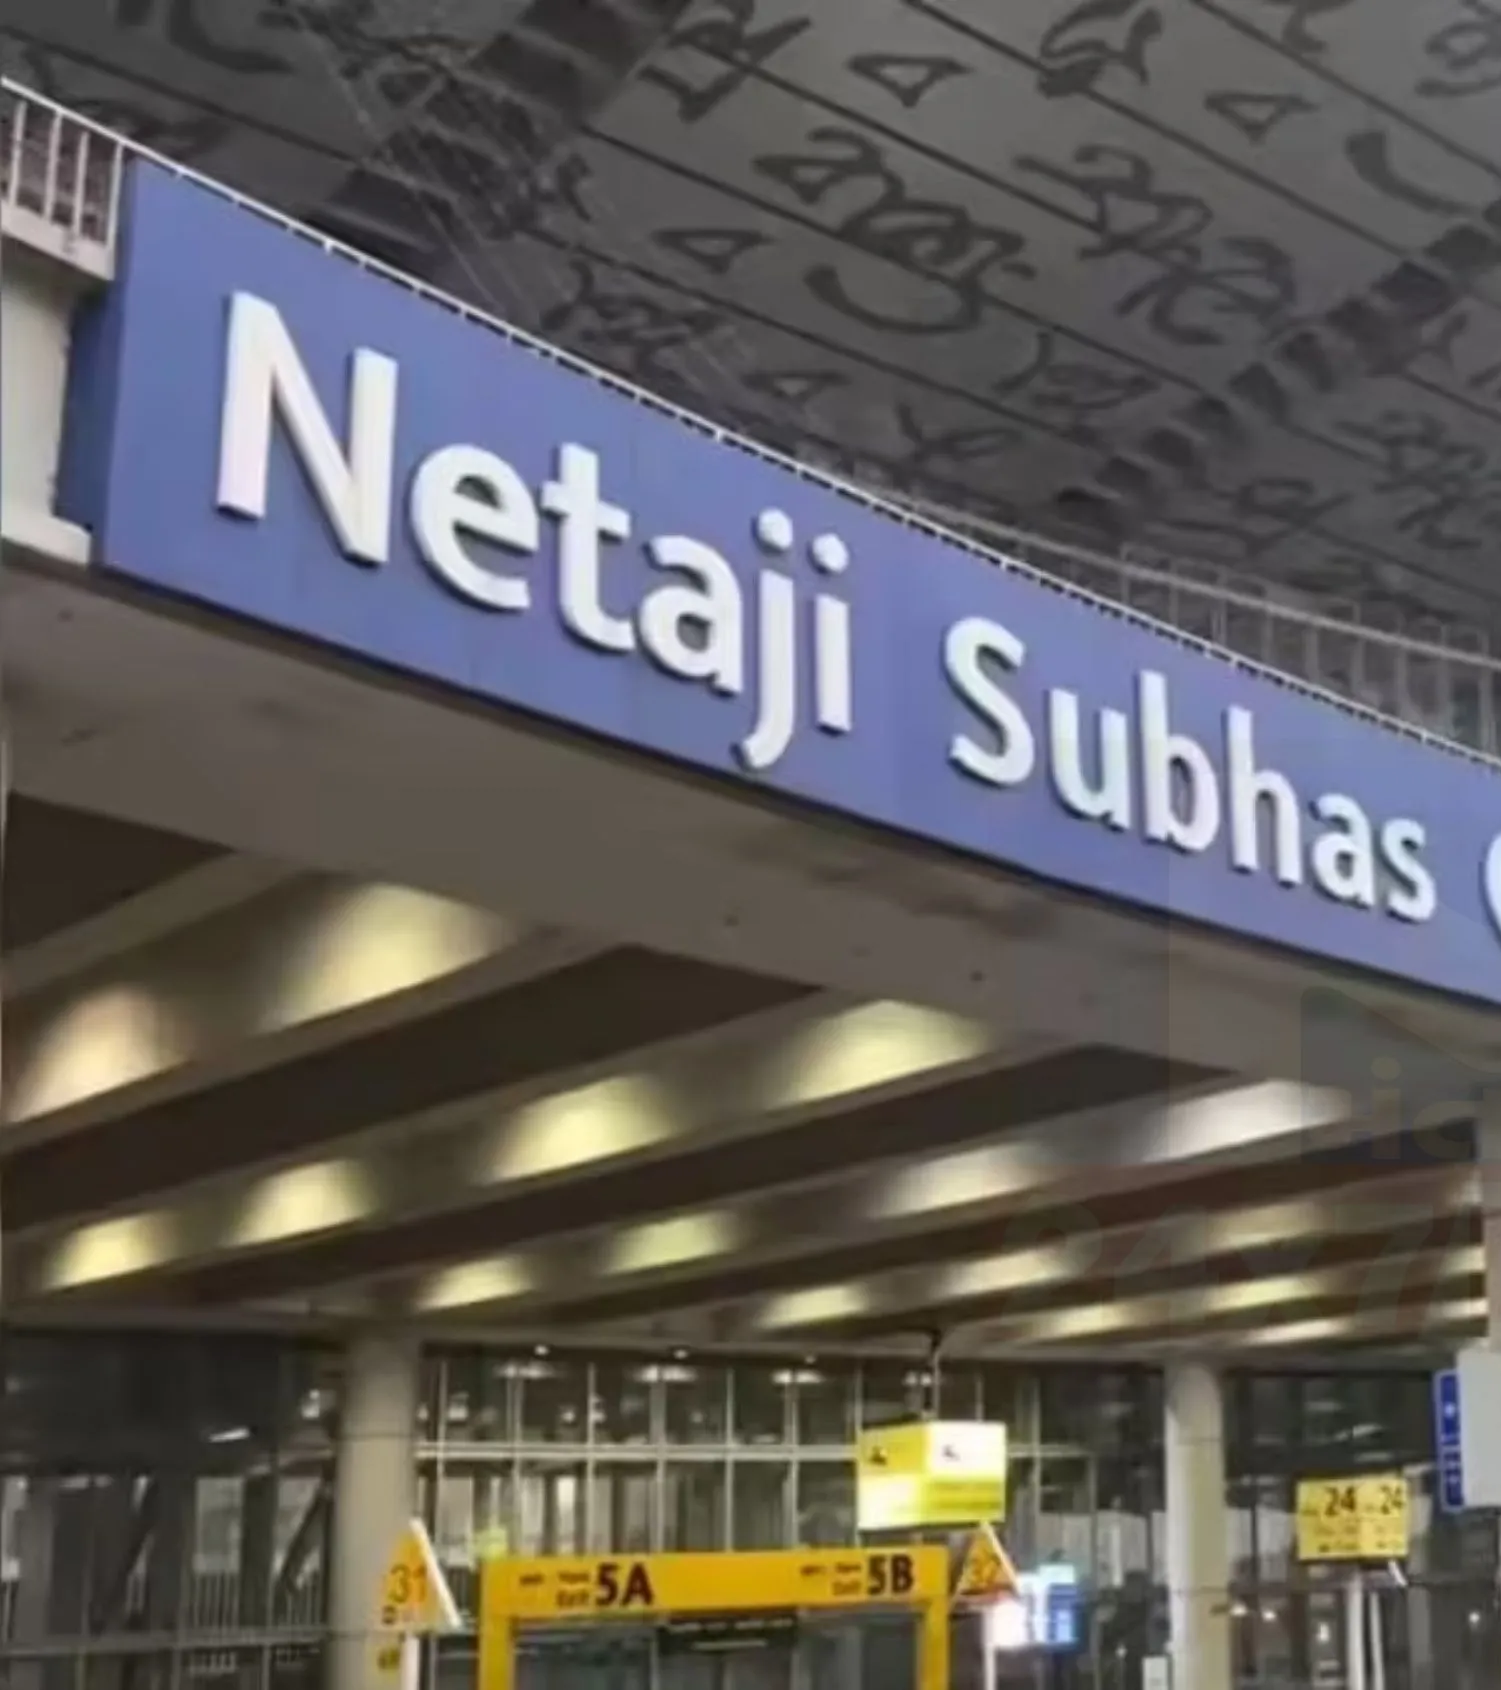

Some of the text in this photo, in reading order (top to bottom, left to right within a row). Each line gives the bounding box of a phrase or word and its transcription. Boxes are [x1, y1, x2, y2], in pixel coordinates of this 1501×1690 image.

[215, 290, 851, 768] Netaji
[944, 616, 1436, 922] Subhas
[596, 1562, 654, 1606] 5A
[868, 1554, 914, 1595] 5B
